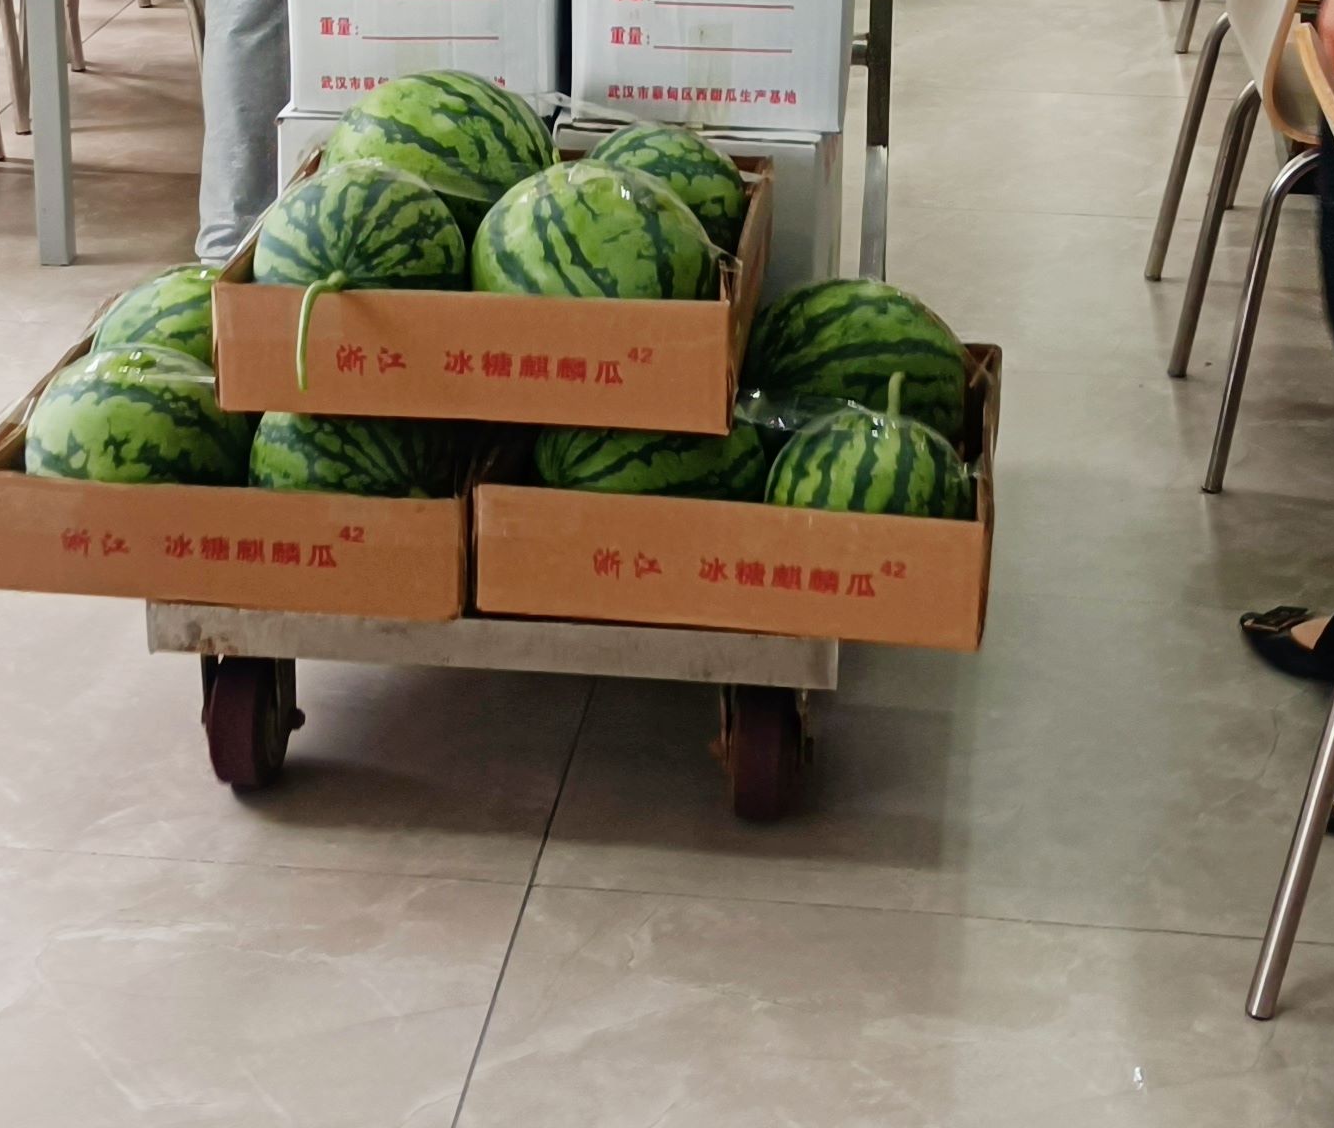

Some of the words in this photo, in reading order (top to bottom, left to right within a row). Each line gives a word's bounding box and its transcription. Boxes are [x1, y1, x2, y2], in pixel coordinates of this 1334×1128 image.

[336, 344, 407, 375] 浙江
[443, 350, 623, 385] 冰糖麒麟瓜
[628, 347, 653, 363] 42
[62, 528, 130, 557] 浙江
[339, 525, 365, 543] 42
[593, 547, 663, 580] 浙江
[879, 560, 906, 578] 42
